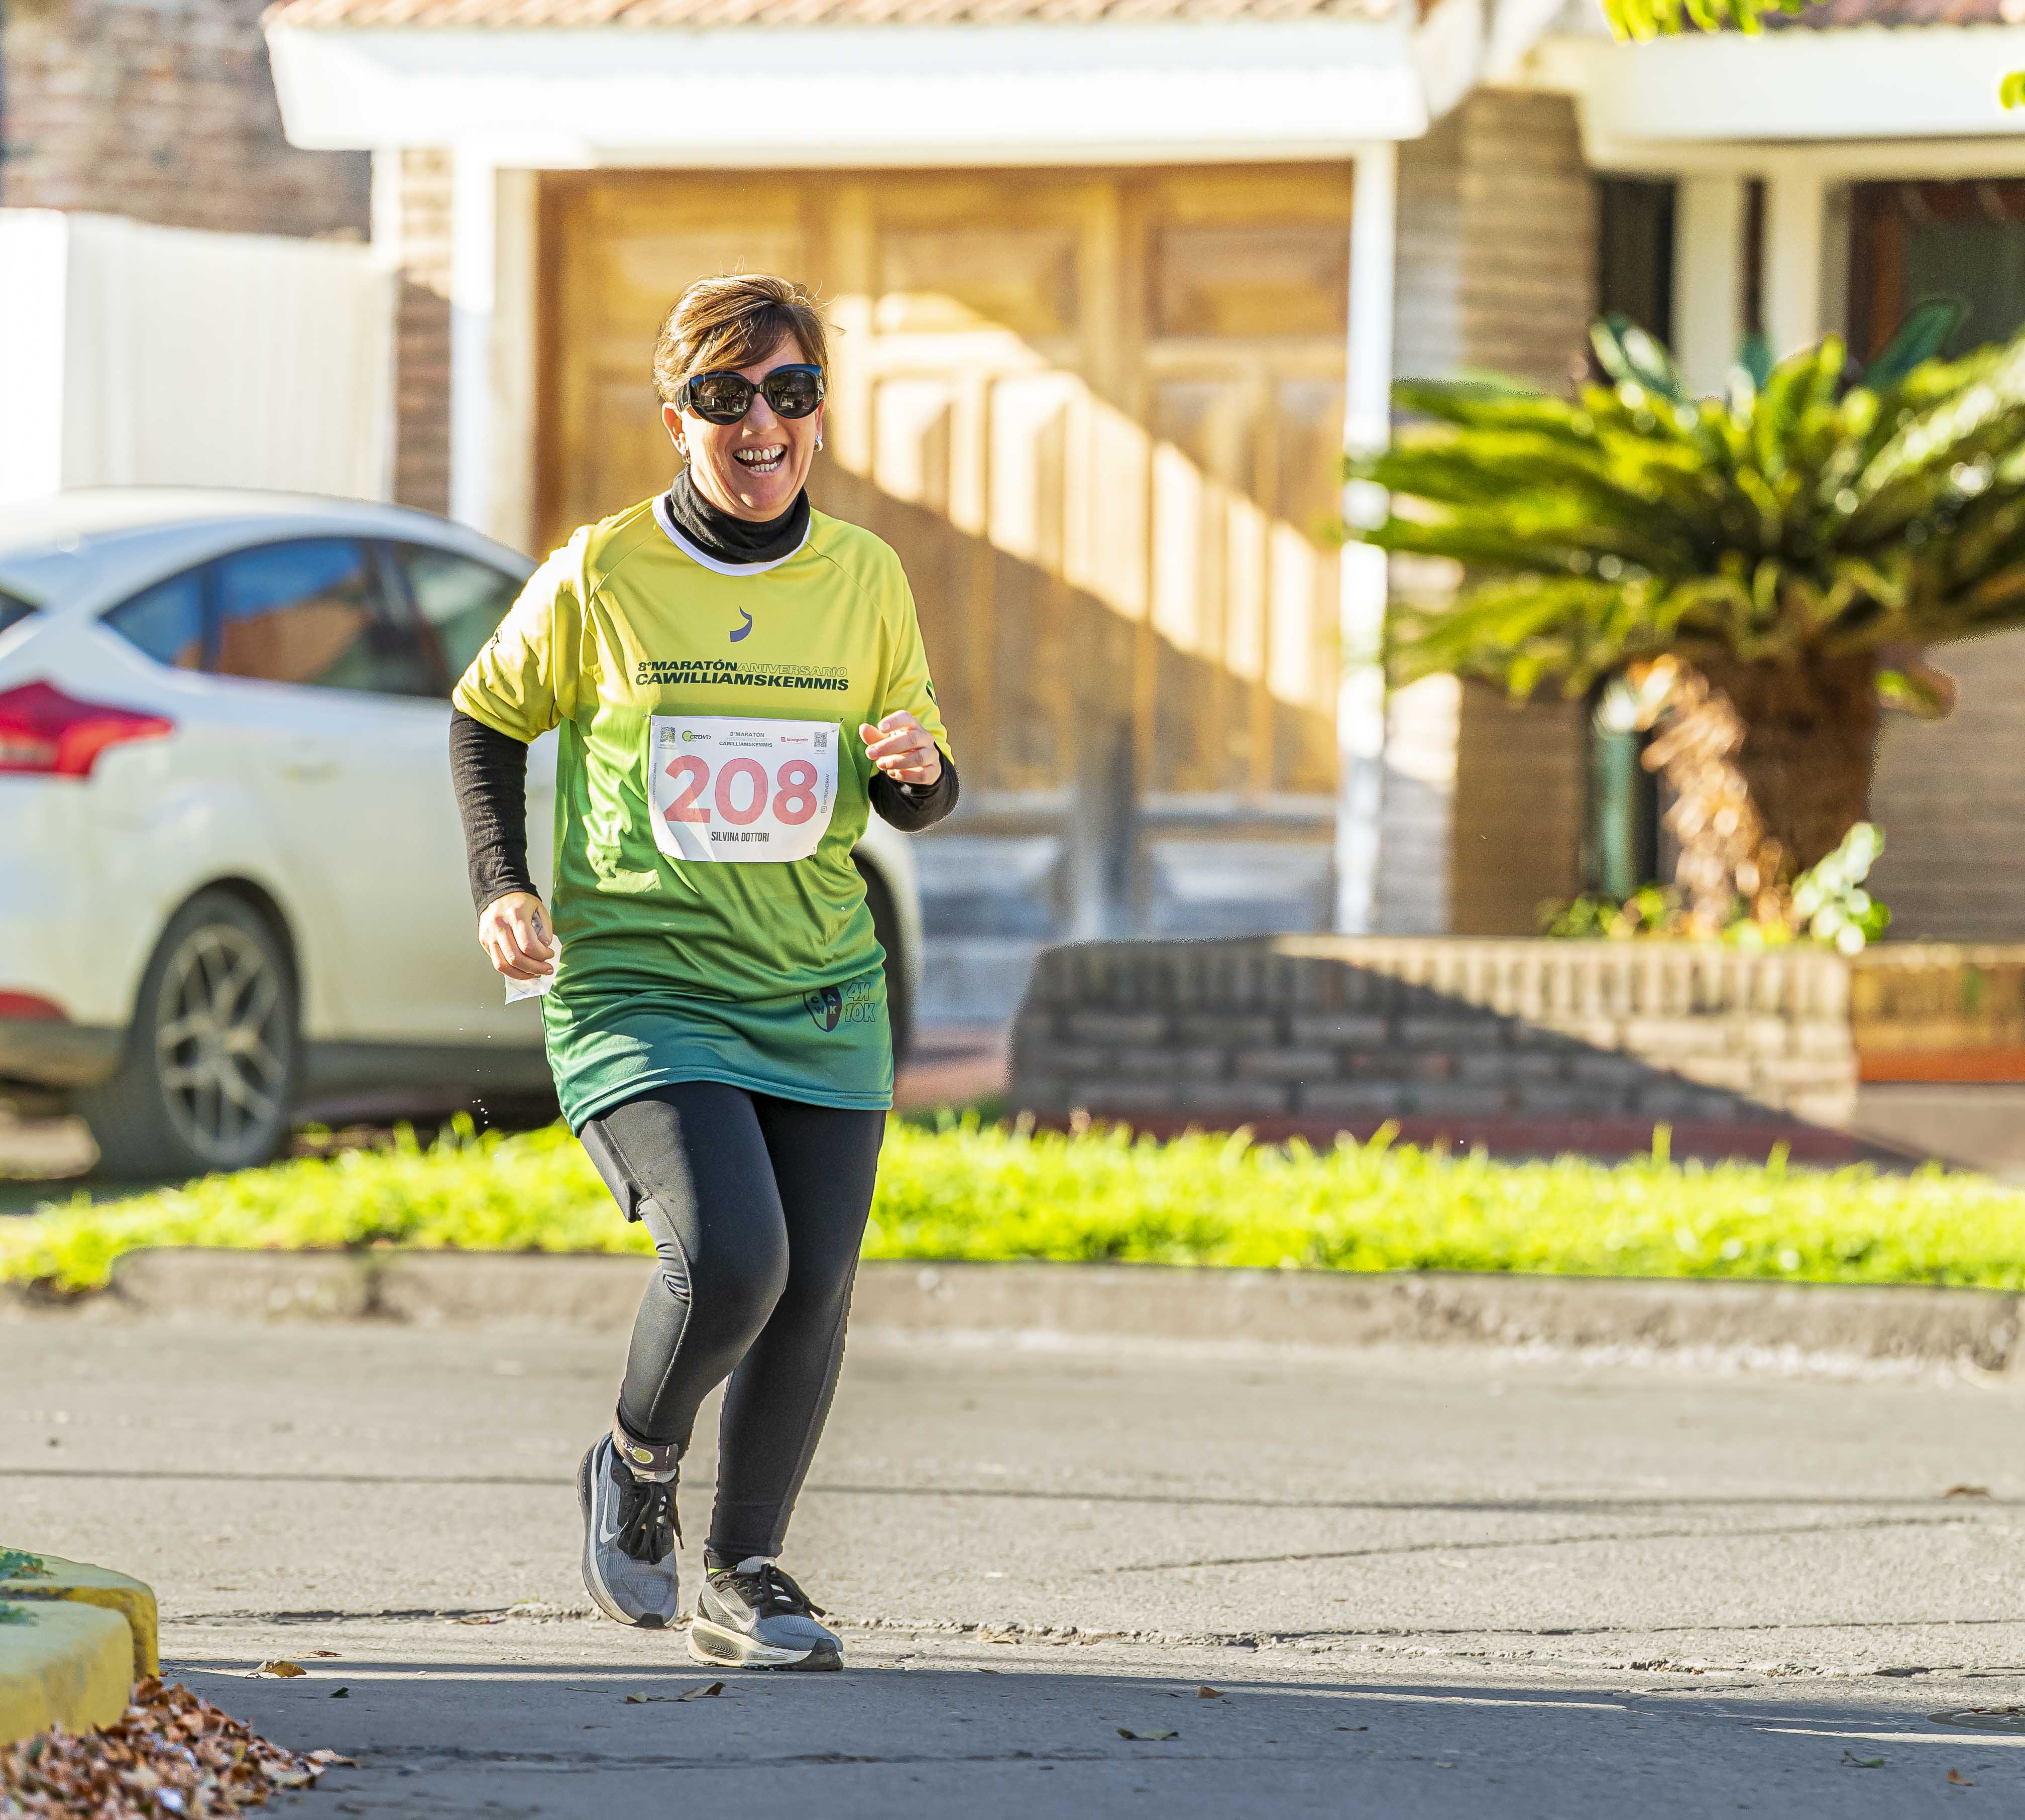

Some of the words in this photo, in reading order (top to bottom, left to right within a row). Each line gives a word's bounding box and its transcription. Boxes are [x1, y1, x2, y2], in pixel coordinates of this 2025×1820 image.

[737, 662, 847, 677] ANIVERSARIO
[636, 672, 848, 691] CAWILLIAMSKEMMIS
[663, 755, 818, 825] 208
[711, 831, 739, 842] SILVINA
[741, 832, 769, 842] DOTTORI
[845, 1002, 875, 1022] 10K
